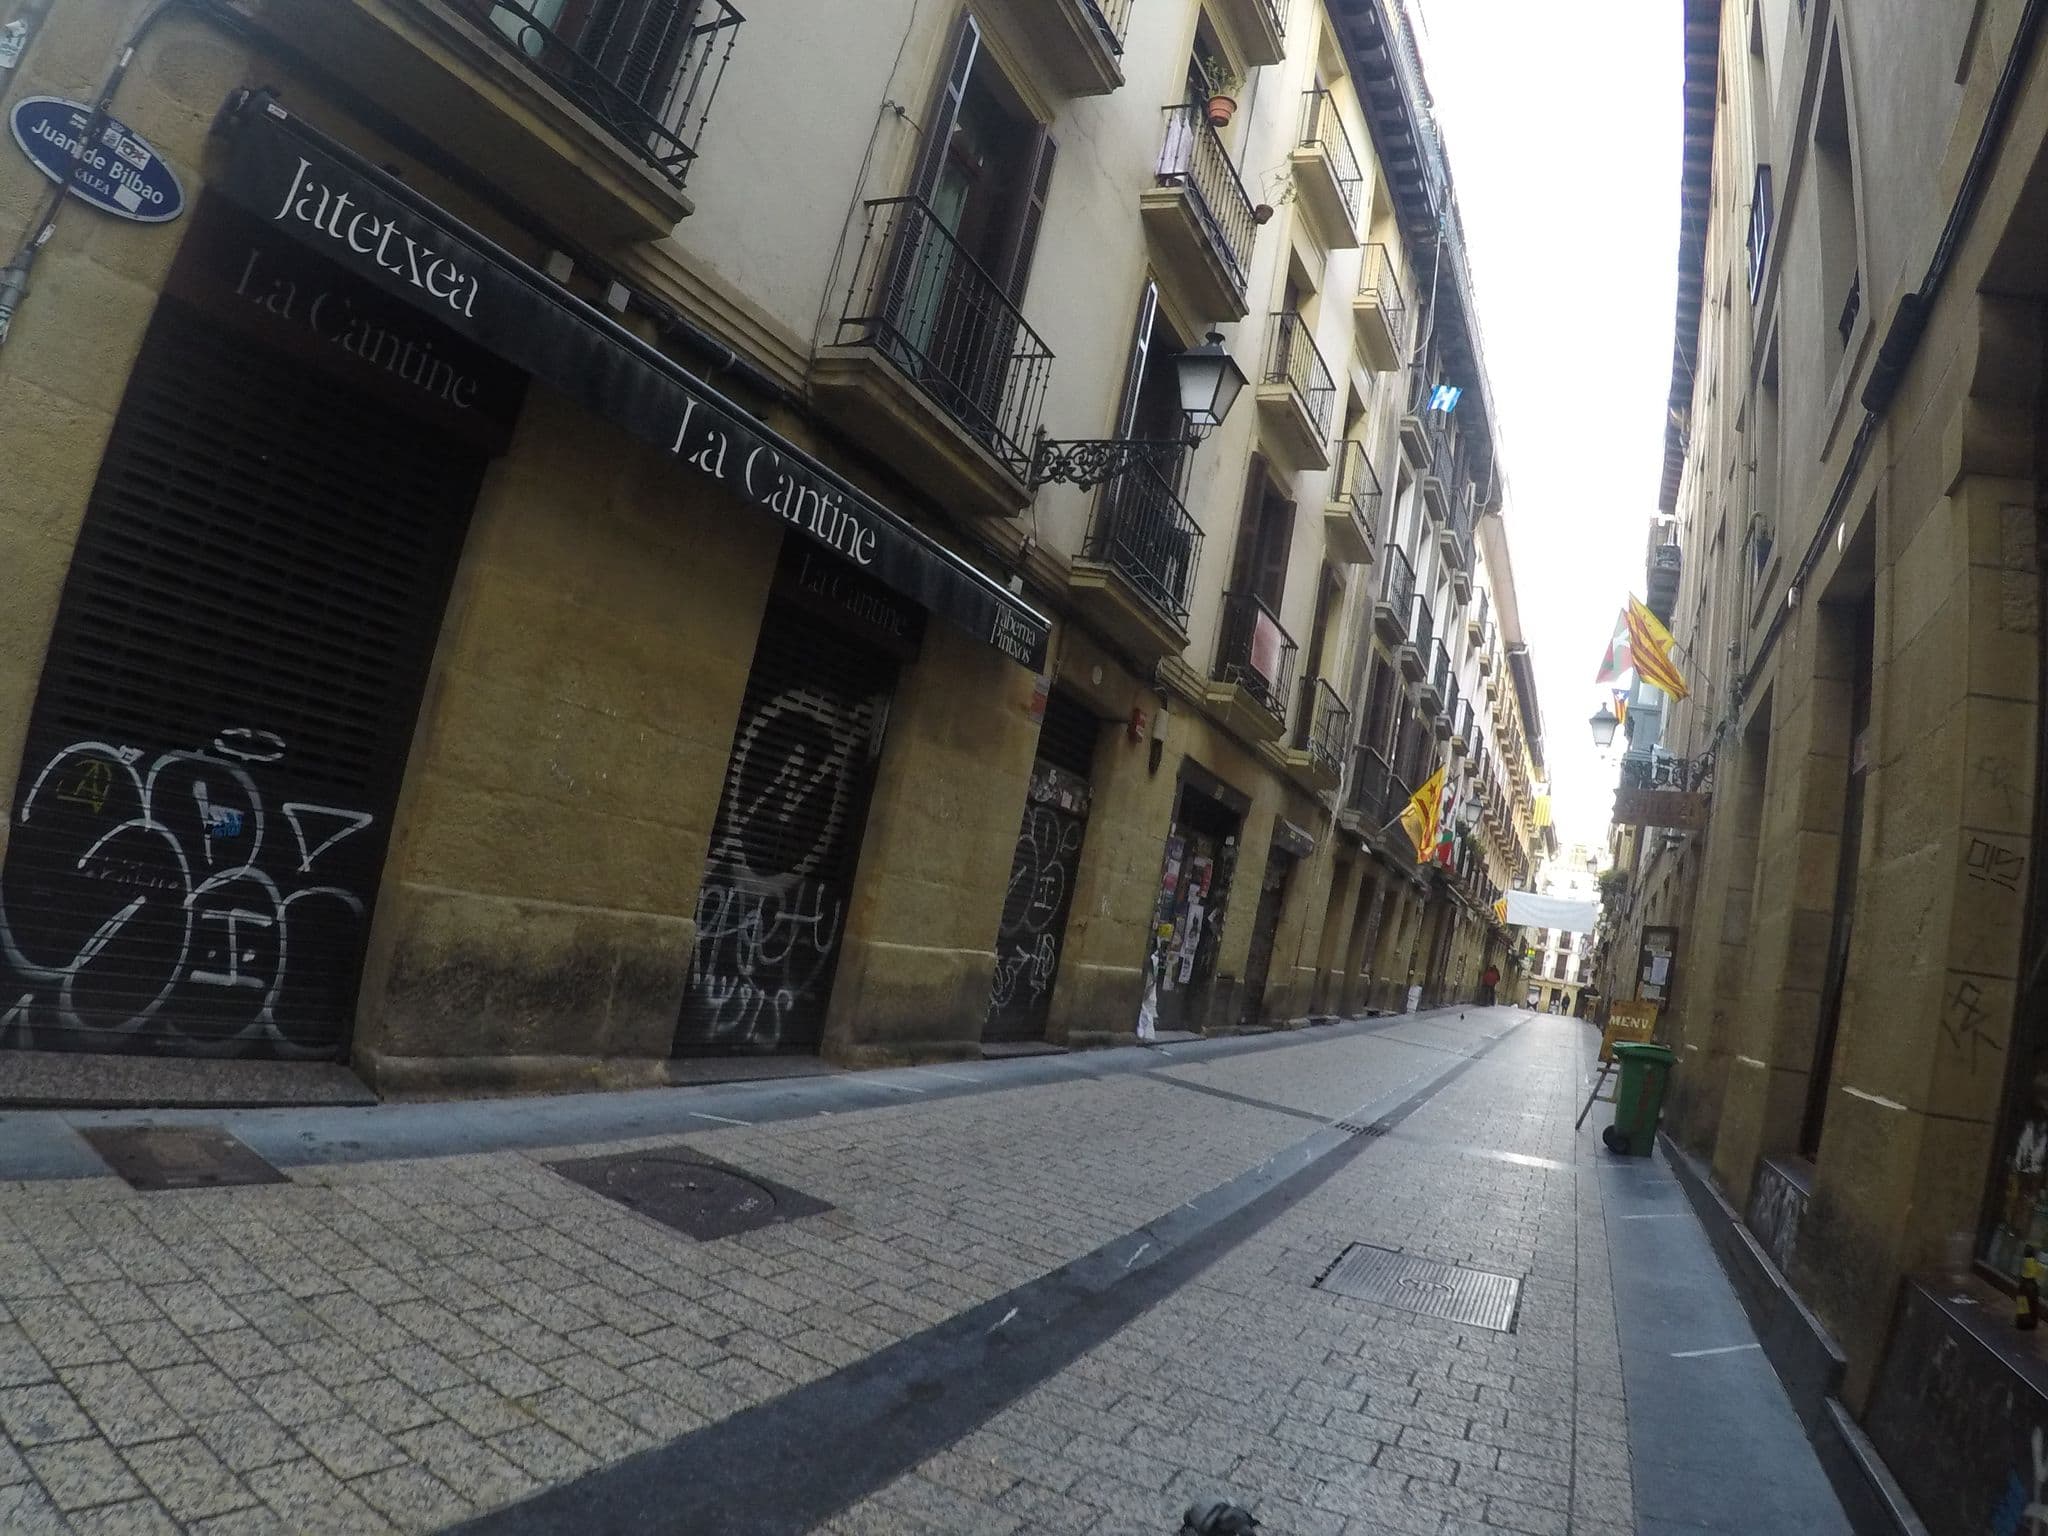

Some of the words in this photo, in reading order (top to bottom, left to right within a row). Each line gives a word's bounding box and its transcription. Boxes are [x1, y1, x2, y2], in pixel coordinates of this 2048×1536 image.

[31, 119, 79, 156] Juan
[82, 148, 106, 170] de
[109, 161, 164, 204] Bilbao
[273, 156, 479, 318] Jatetxea
[236, 248, 296, 320] La
[310, 292, 478, 409] Cantine
[671, 396, 727, 479] La
[745, 445, 877, 566] Cantine
[990, 623, 1032, 664] Pintxos
[996, 601, 1036, 647] Taberna
